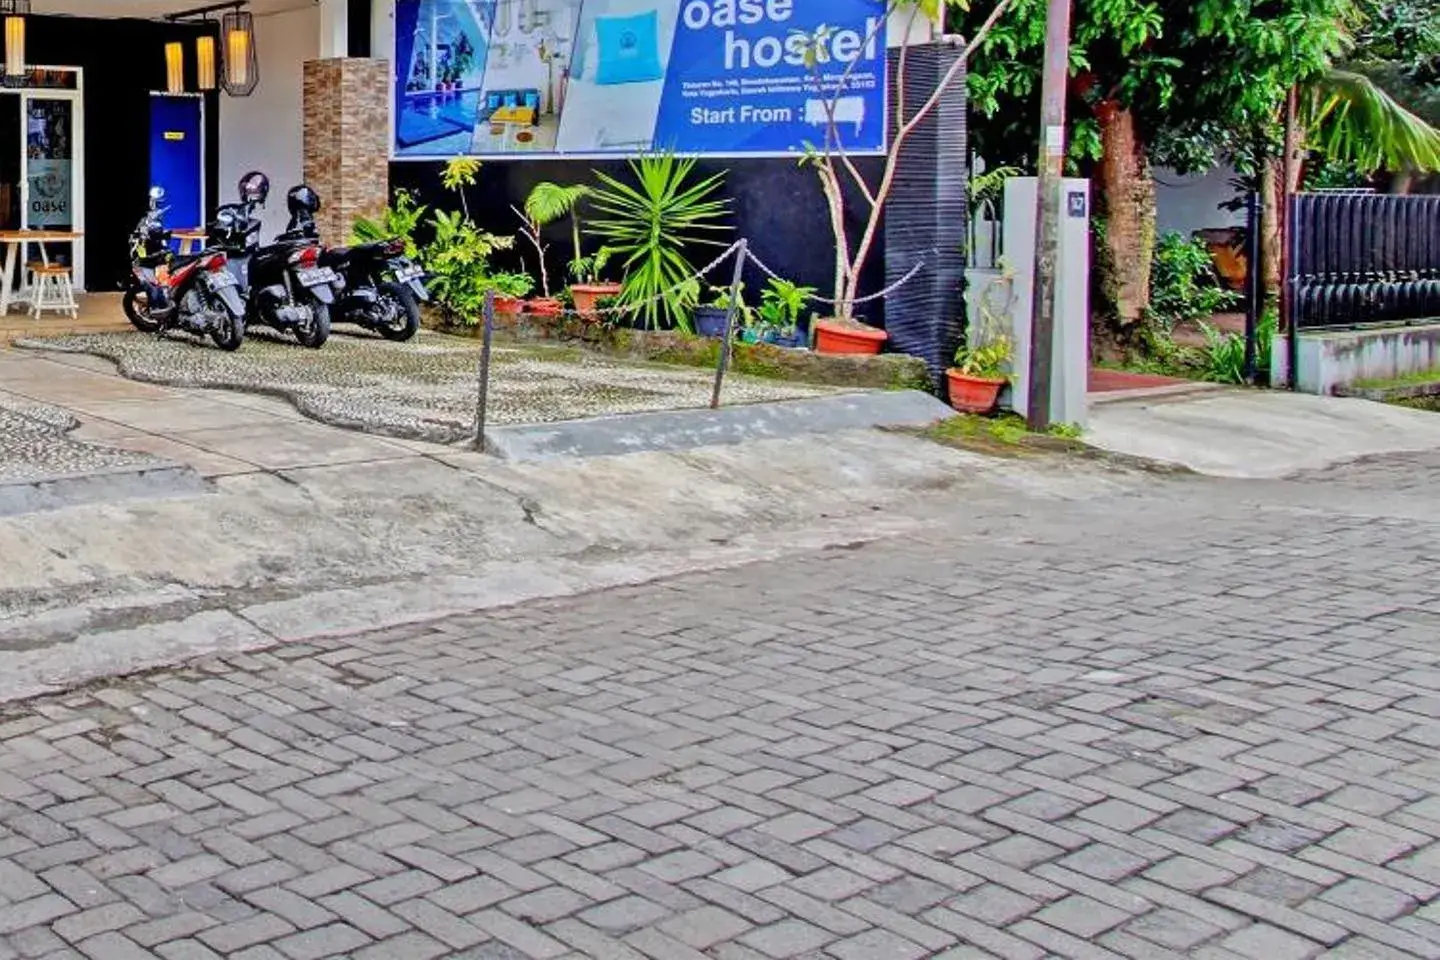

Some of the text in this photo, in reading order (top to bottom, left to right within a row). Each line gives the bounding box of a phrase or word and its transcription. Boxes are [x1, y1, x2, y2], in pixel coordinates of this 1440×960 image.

[723, 17, 877, 70] hostel
[690, 106, 735, 125] Start
[740, 104, 791, 123] From
[32, 200, 66, 213] oase
